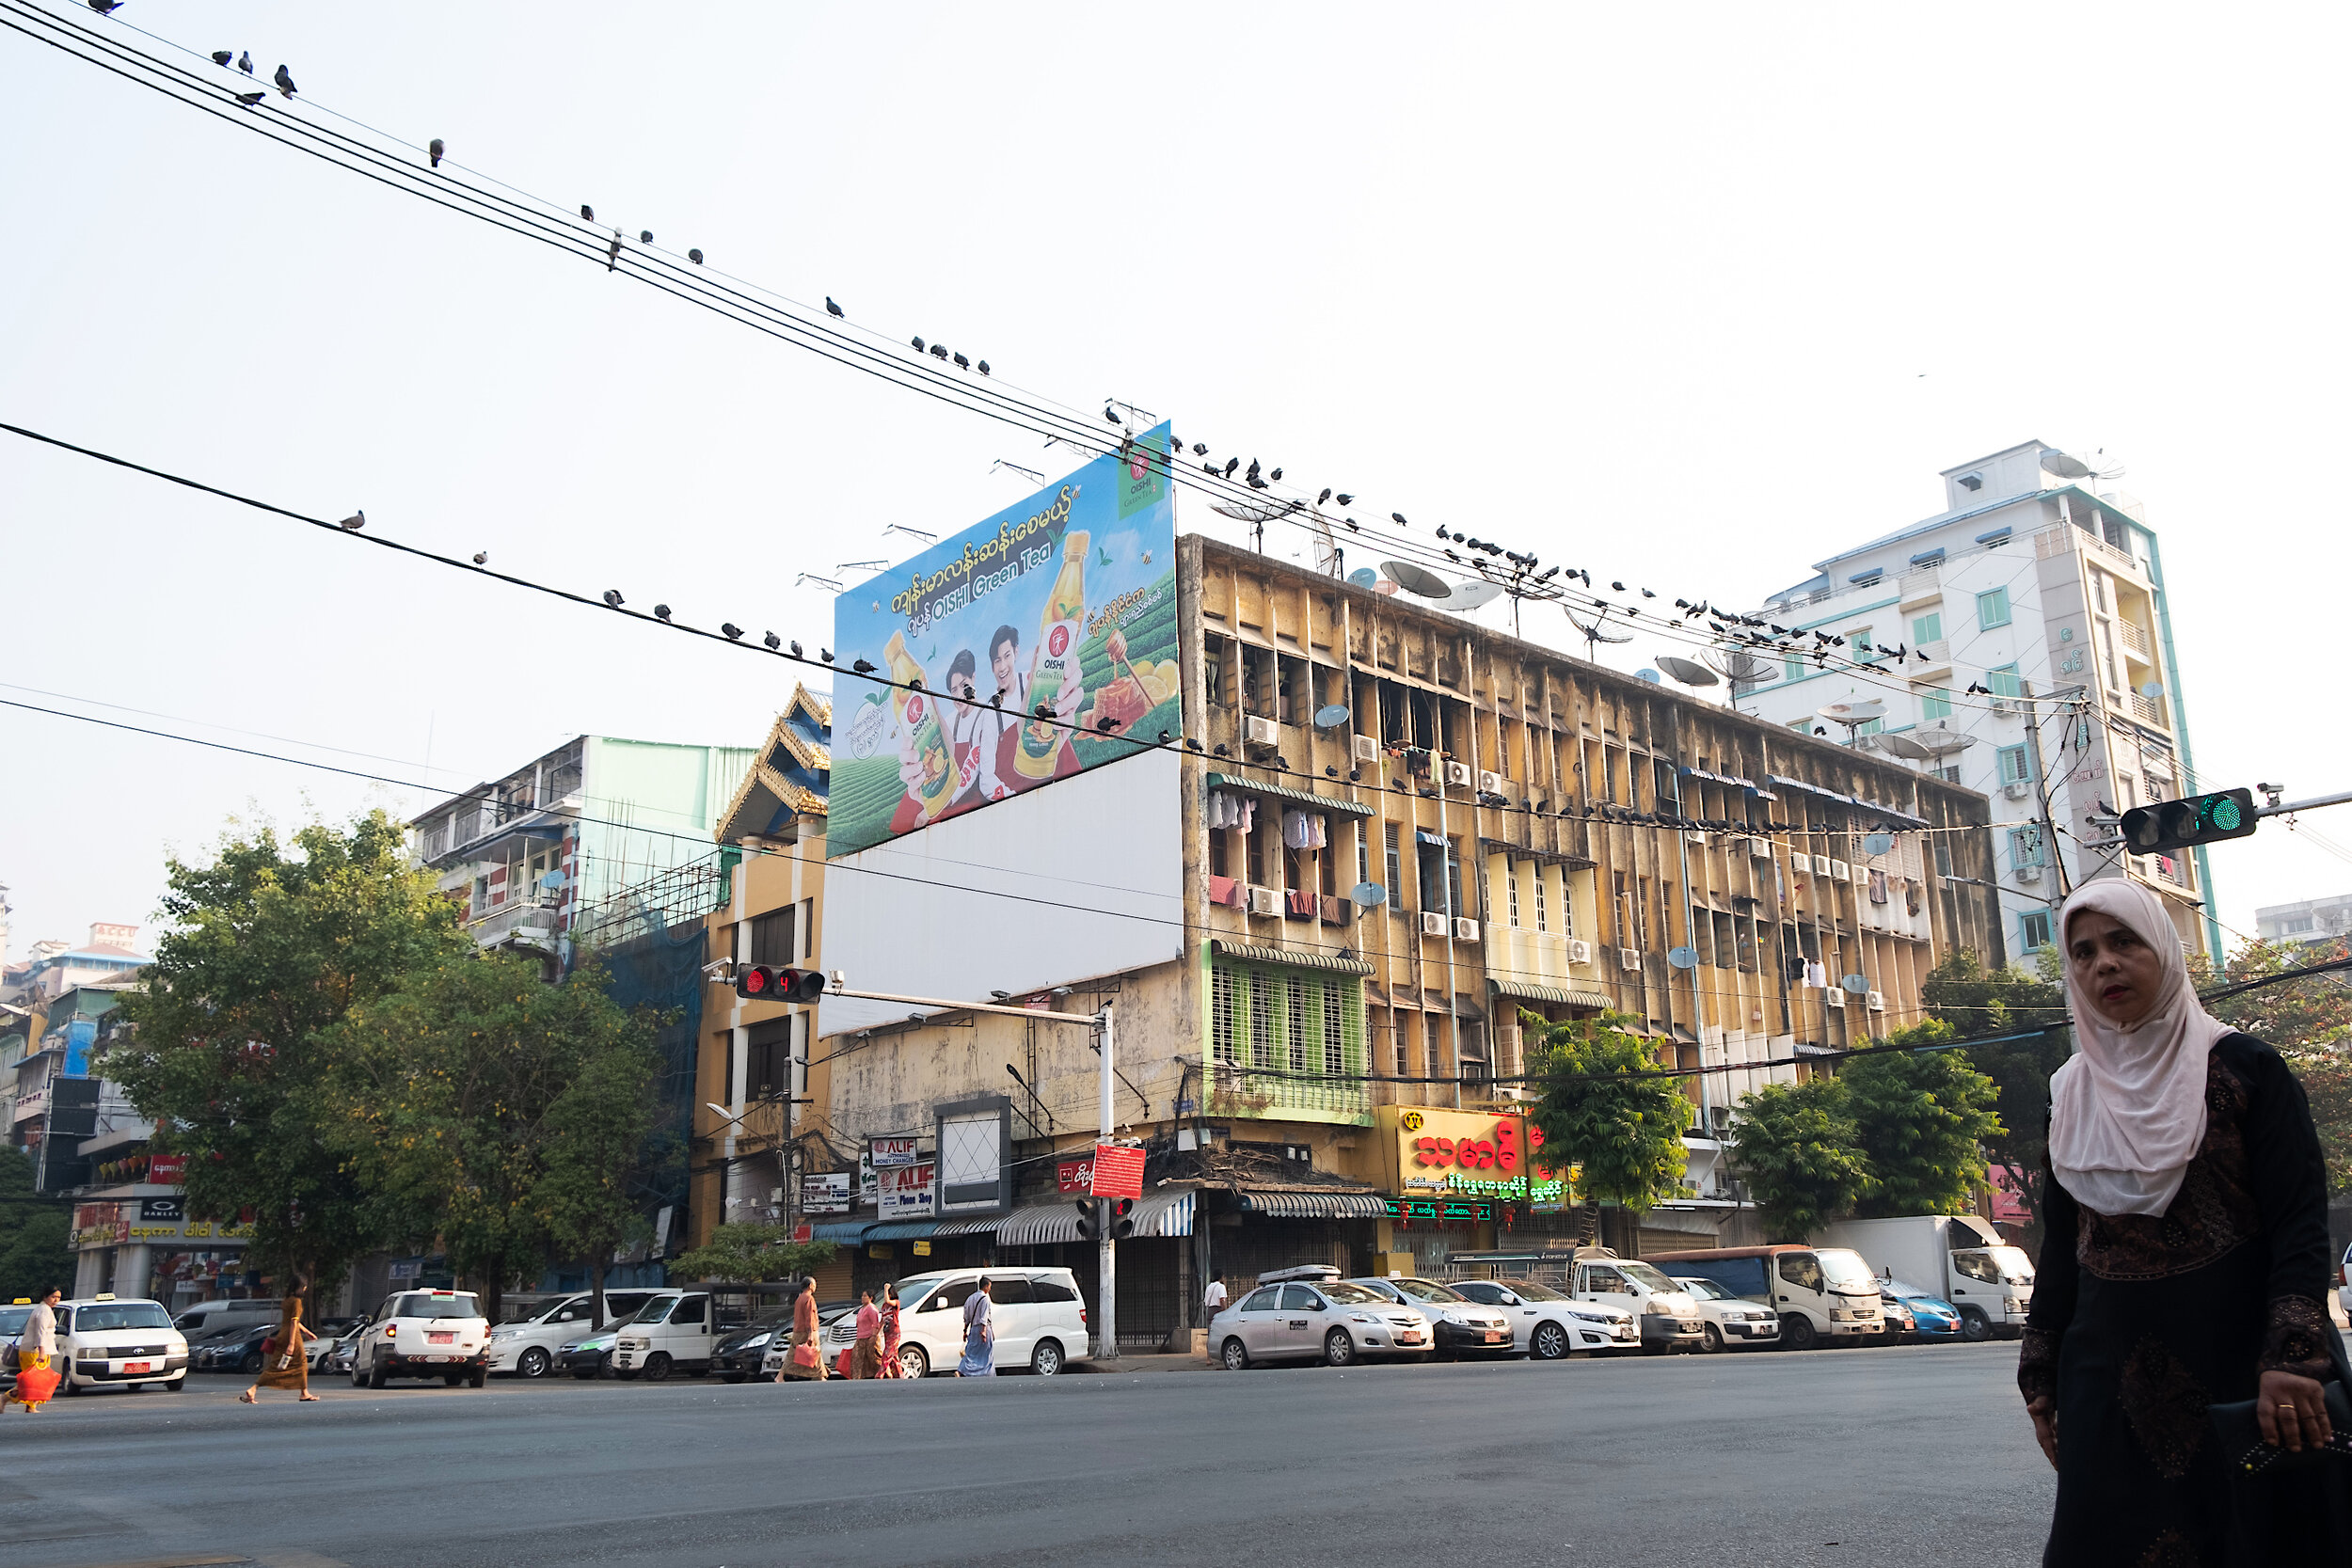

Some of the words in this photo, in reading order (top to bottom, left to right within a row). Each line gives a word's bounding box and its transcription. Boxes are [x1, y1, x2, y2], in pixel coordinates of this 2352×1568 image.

[1131, 477, 1151, 494] OISHI
[932, 583, 970, 621] OISHI
[973, 562, 1019, 599] Green
[1021, 542, 1052, 573] Tea
[1044, 659, 1065, 670] OISHI
[913, 713, 930, 736] OISHI
[887, 1140, 914, 1153] ALIF
[893, 1156, 914, 1164] CHANGER
[897, 1165, 934, 1191] ALIF
[899, 1194, 916, 1206] Phone
[919, 1193, 932, 1205] Shop
